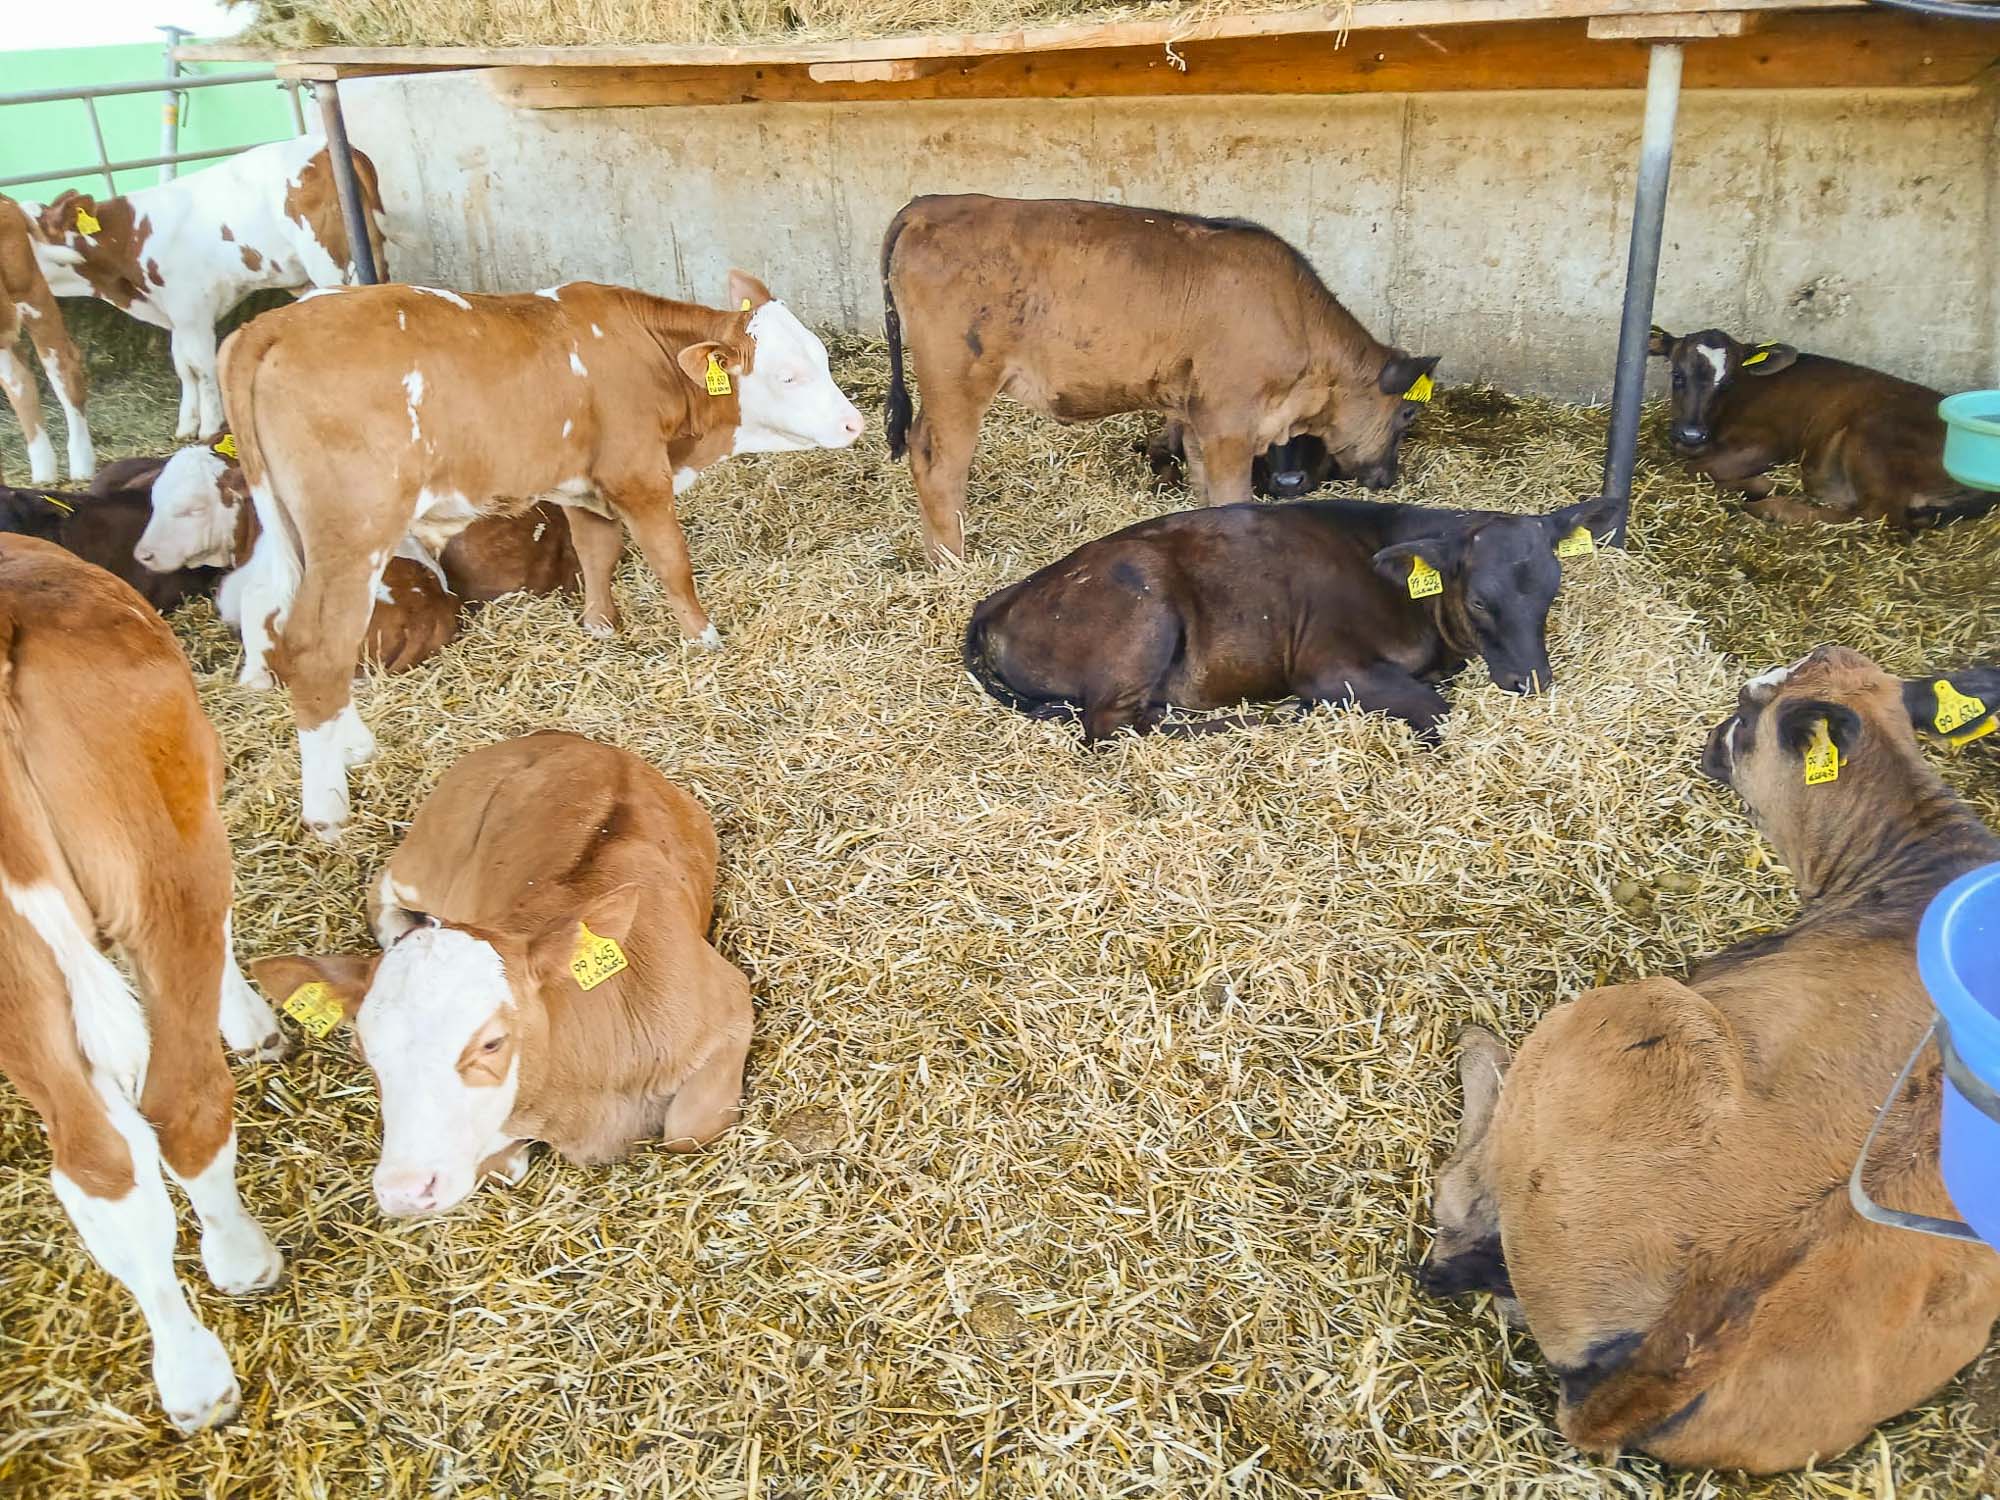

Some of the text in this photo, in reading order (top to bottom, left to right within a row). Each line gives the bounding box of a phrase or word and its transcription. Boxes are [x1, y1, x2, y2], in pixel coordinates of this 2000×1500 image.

[1410, 577, 1420, 589] 99
[1939, 714, 1953, 731] 99
[573, 960, 588, 978] 99
[594, 944, 616, 966] 645
